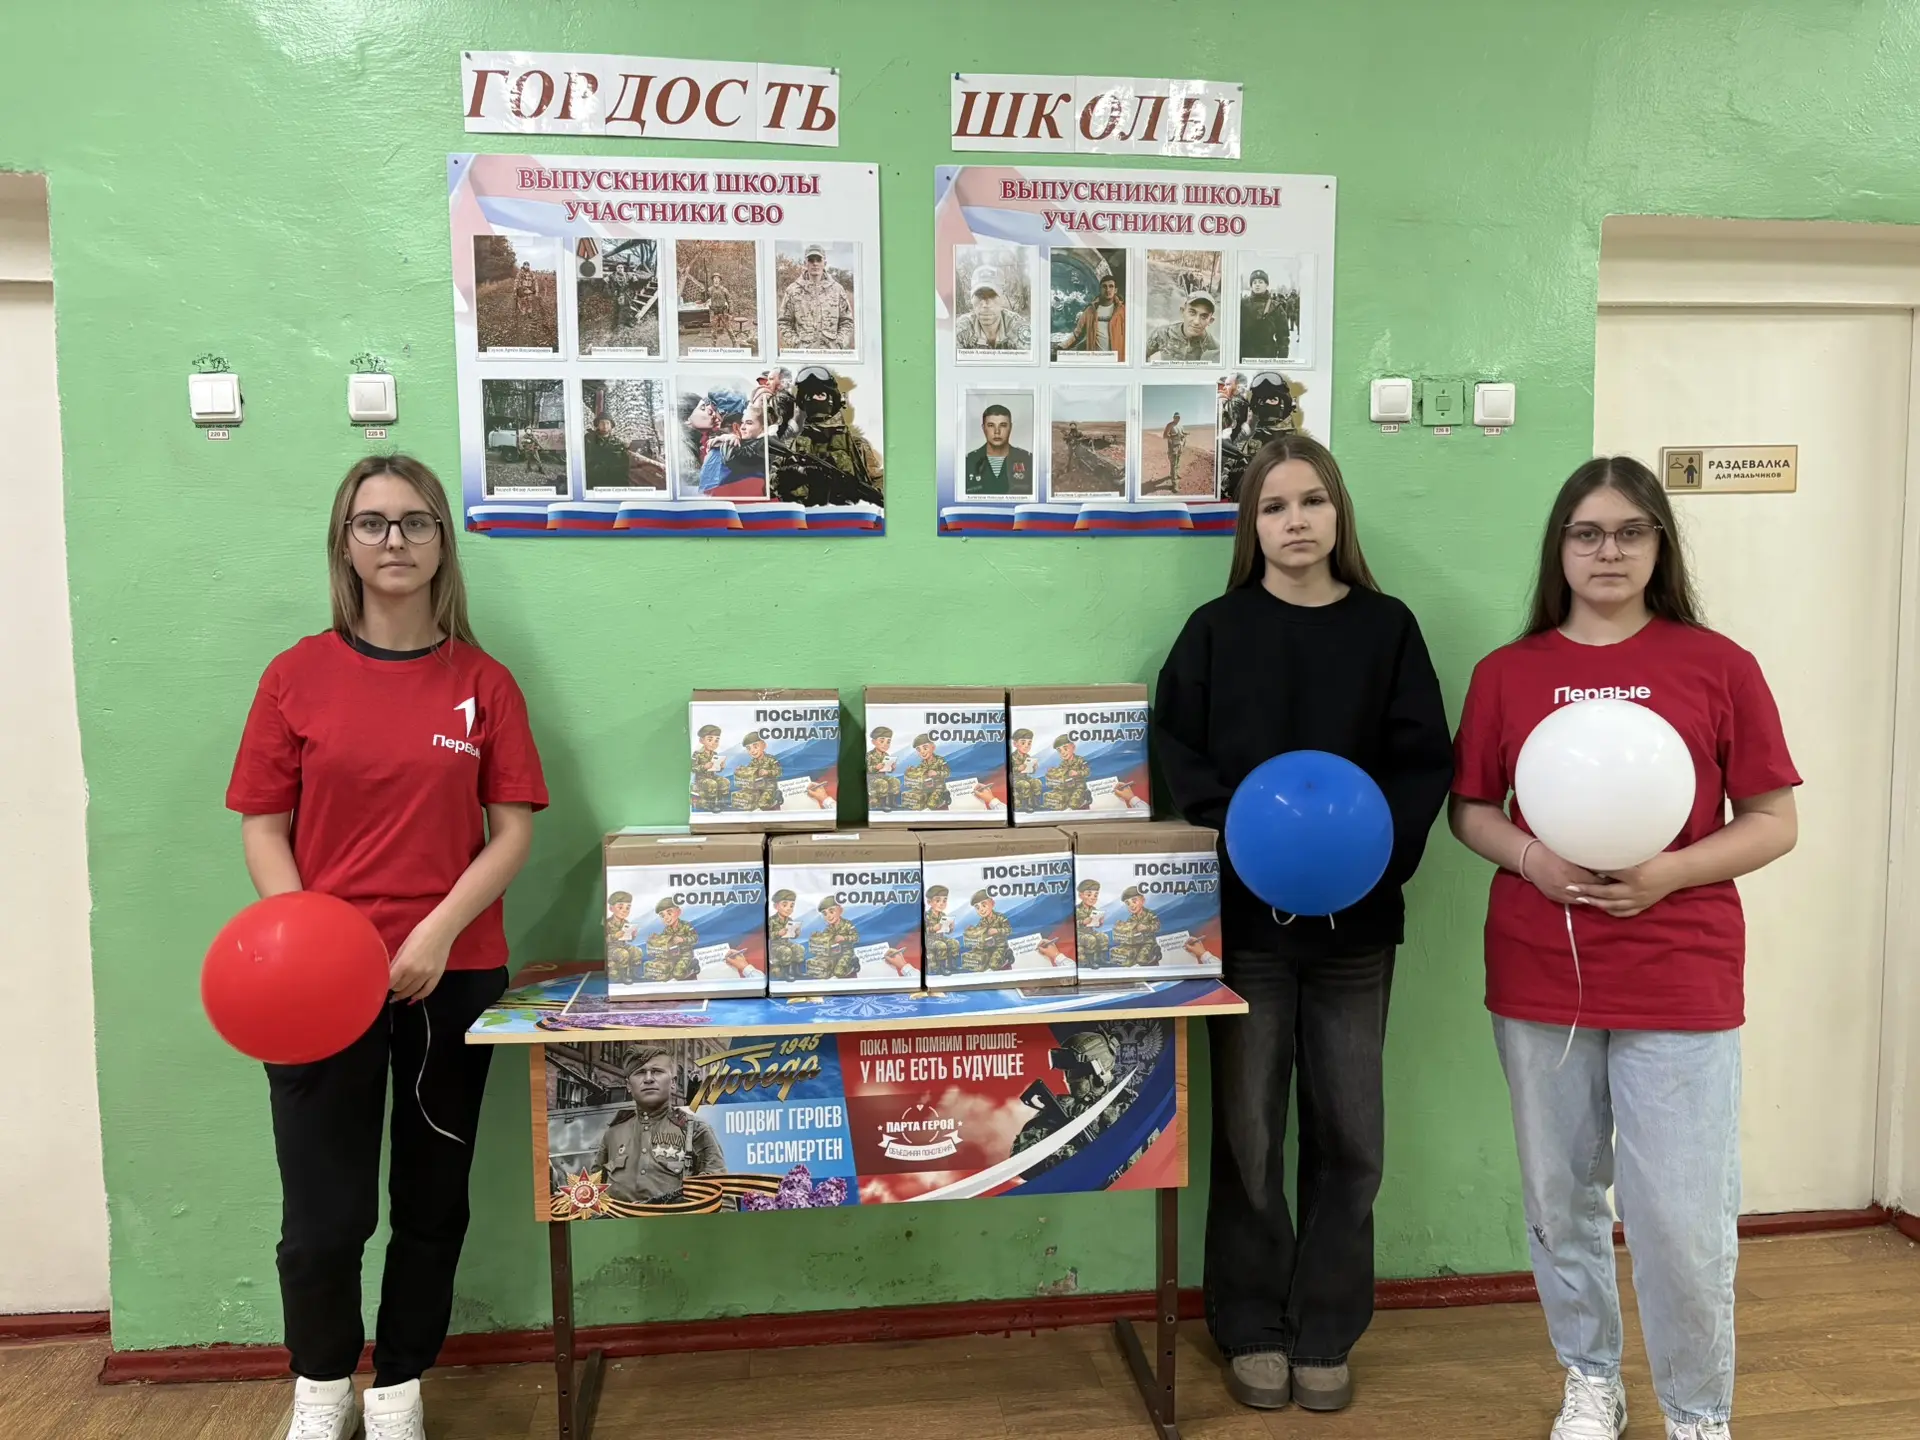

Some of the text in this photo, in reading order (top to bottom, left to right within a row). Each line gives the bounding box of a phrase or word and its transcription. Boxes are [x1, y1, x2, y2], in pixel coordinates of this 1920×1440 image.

[464, 69, 836, 135] ГОРДОСТЬ
[952, 91, 1235, 145] ШКОЛЫ
[518, 169, 820, 195] ВЫПУСКНИКИ ШКОЛЫ
[1001, 180, 1281, 206] ВЫПУСКНИКИ ШКОЛЫ
[563, 200, 784, 224] УЧАСТНИКИ СВО
[1043, 211, 1246, 235] УЧАСТНИКИ СВО
[1708, 459, 1790, 471] РАЗДЕВАЛКА
[756, 709, 840, 722] ПОСЫЛКА
[1065, 711, 1148, 724] ПОСЫЛКА
[760, 727, 839, 741] СОЛДАТУ
[929, 729, 1006, 743] СОЛДАТУ
[1068, 728, 1145, 742] СОЛДАТУ
[983, 862, 1072, 880] ПОСЫЛКА
[1135, 861, 1220, 876] ПОСЫЛКА
[669, 871, 763, 887] ПОСЫЛКА
[832, 872, 921, 886] ПОСЫЛКА
[1138, 880, 1218, 895] СОЛДАТУ
[987, 880, 1069, 897] СОЛДАТУ
[673, 890, 760, 906] СОЛДАТУ
[836, 890, 919, 905] СОЛДАТУ
[778, 1033, 824, 1055] 1945
[860, 1038, 888, 1056] ПОКА
[892, 1037, 912, 1055] МЫ
[915, 1034, 963, 1054] ПОМНИМ
[860, 1053, 1024, 1084] У НАС ЕСТЬ БУДУЩЕЕ
[689, 1042, 822, 1113] Победа
[725, 1105, 842, 1135] ПОДВИГ ГЕРОЕВ
[886, 1118, 954, 1133] ПАРТА ГЕРОЯ
[747, 1138, 842, 1165] БЕССМЕРТЕН
